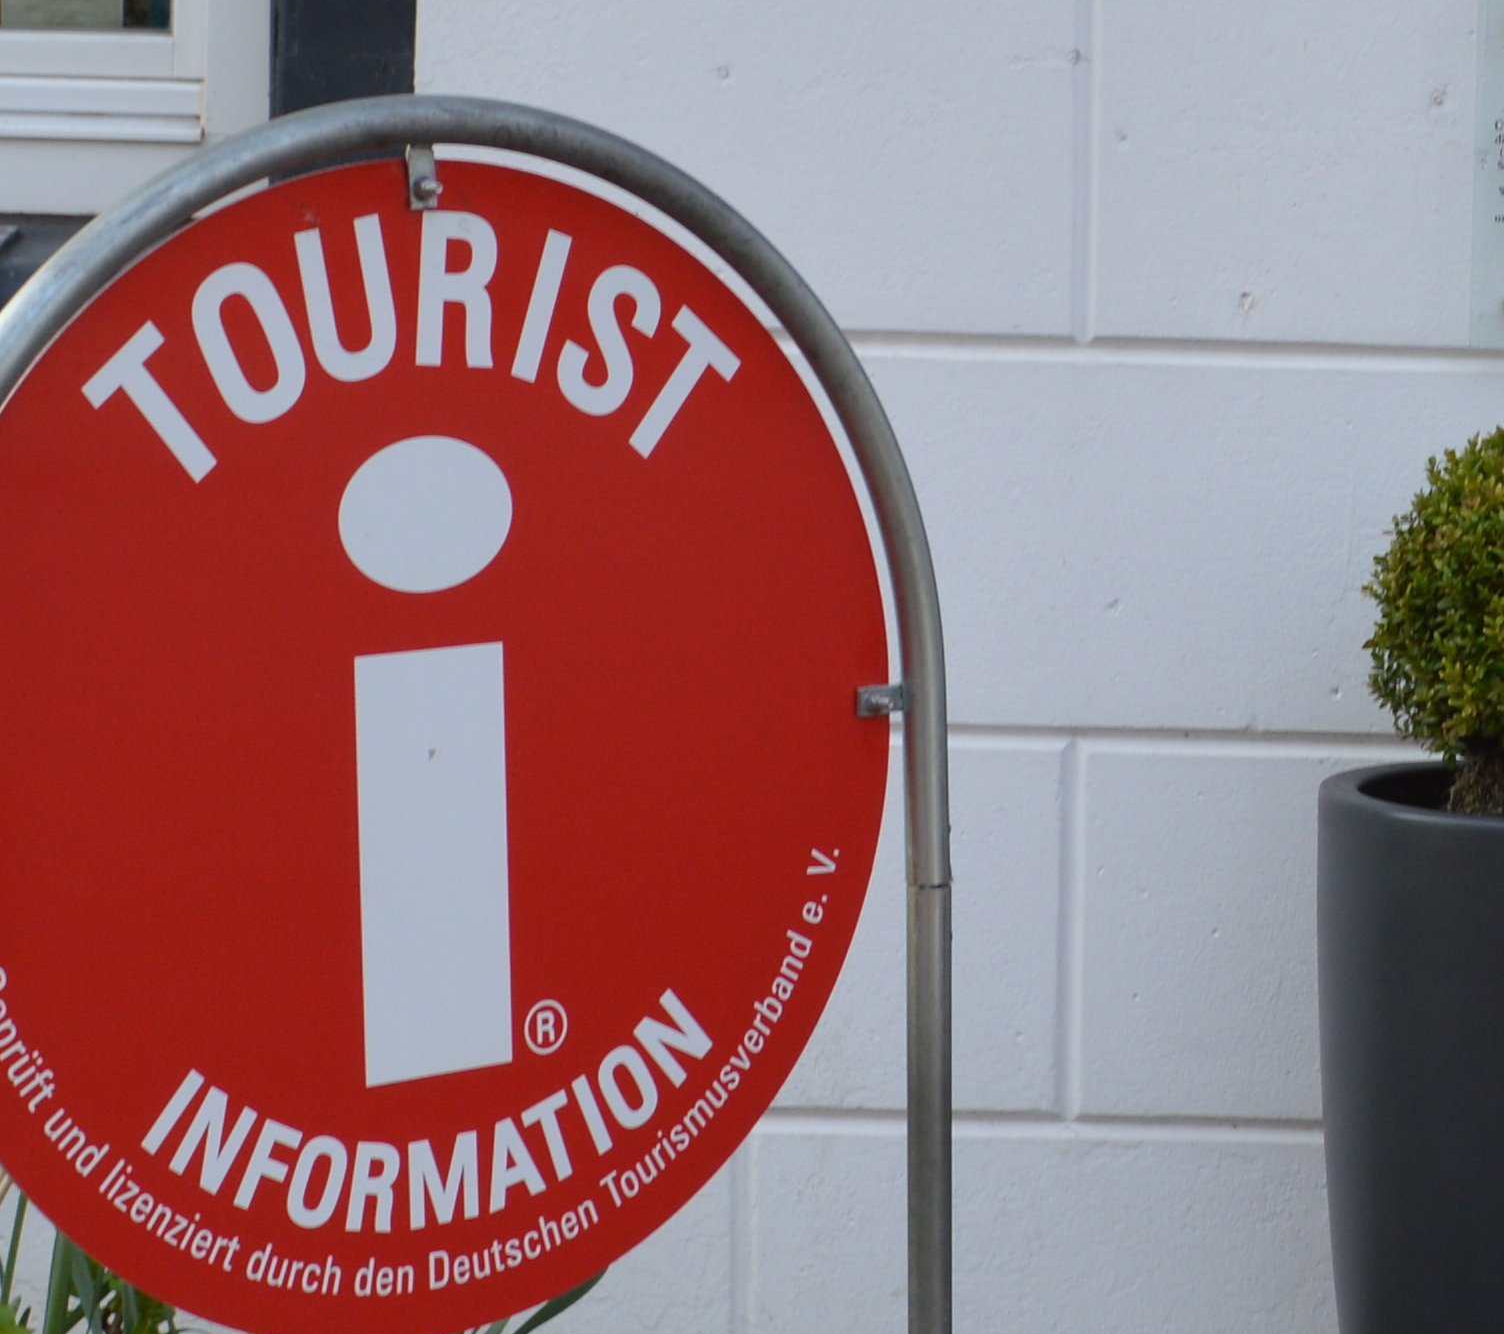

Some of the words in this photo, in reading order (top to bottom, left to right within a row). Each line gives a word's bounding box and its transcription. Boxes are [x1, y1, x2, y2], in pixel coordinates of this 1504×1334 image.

[80, 209, 742, 485] TOURIST
[805, 846, 840, 876] V.
[802, 893, 828, 925] e.
[599, 928, 813, 1208] Tourismusverband
[43, 1107, 110, 1177] und
[140, 987, 714, 1234] INFORMATION
[98, 1158, 240, 1273] lizenziert
[428, 1198, 599, 1291] Deutschen
[245, 1242, 342, 1296] durch
[353, 1257, 415, 1297] den
